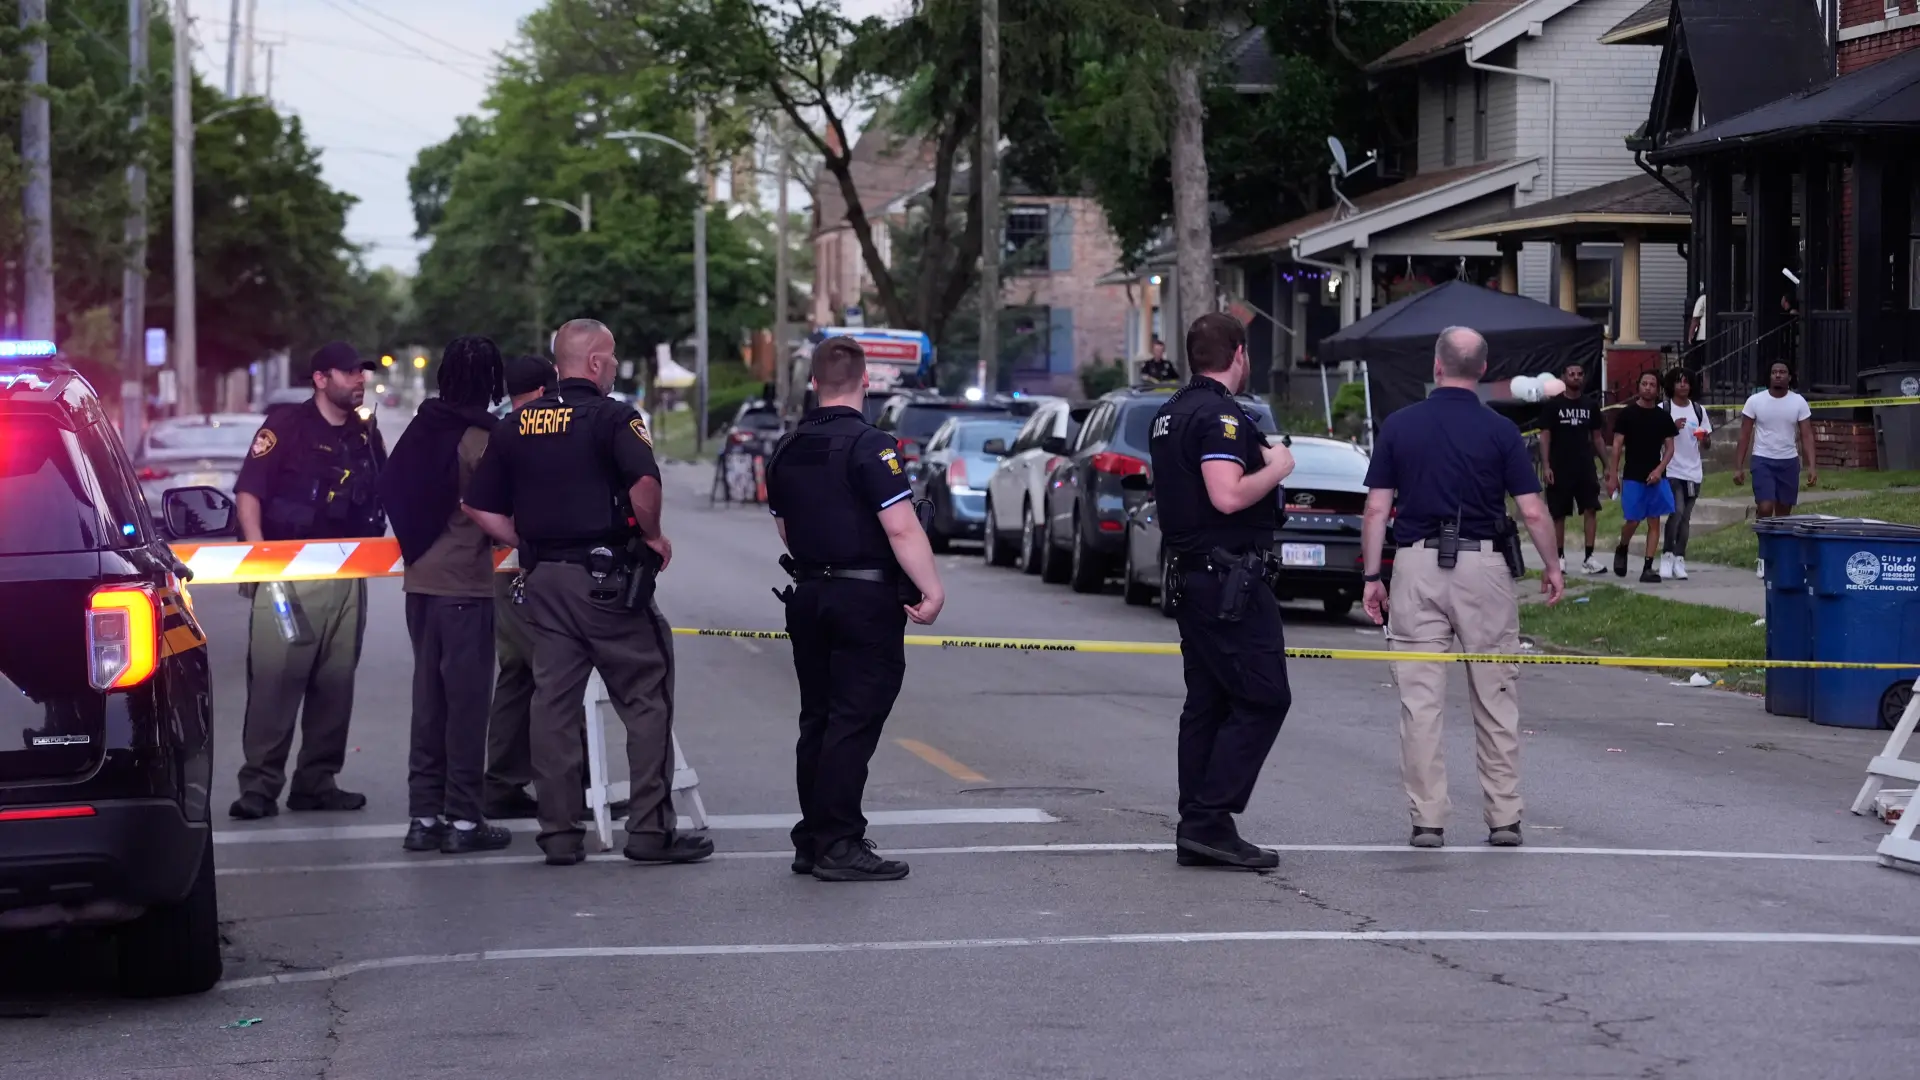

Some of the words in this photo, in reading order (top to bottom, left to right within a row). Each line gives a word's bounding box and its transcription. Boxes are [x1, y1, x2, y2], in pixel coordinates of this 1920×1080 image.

[1558, 408, 1591, 419] AMIRI
[519, 408, 573, 435] SHERIFF
[1152, 415, 1171, 438] OLICE
[1881, 555, 1901, 563] City
[1881, 563, 1915, 572] Toledo
